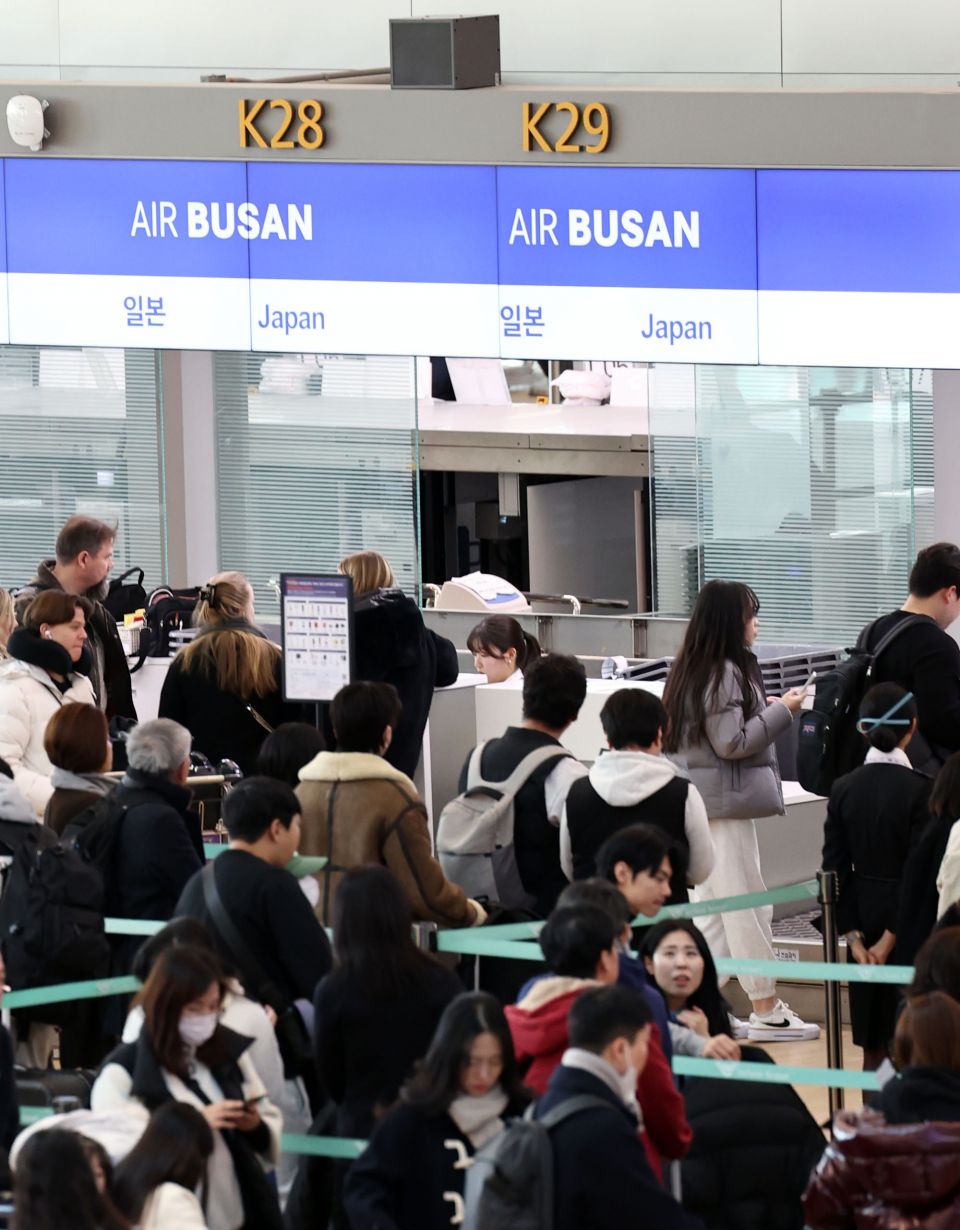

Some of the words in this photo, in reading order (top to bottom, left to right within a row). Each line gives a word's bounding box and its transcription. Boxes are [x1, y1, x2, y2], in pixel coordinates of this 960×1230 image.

[238, 98, 325, 150] K28
[521, 101, 610, 154] K29
[130, 201, 179, 237] AIR
[187, 202, 313, 241] BUSAN
[508, 208, 559, 245] AIR
[568, 210, 700, 248] BUSAN
[123, 295, 165, 327] 일본
[258, 304, 325, 336] Japan
[500, 304, 545, 338] 일본
[641, 313, 712, 346] Japan
